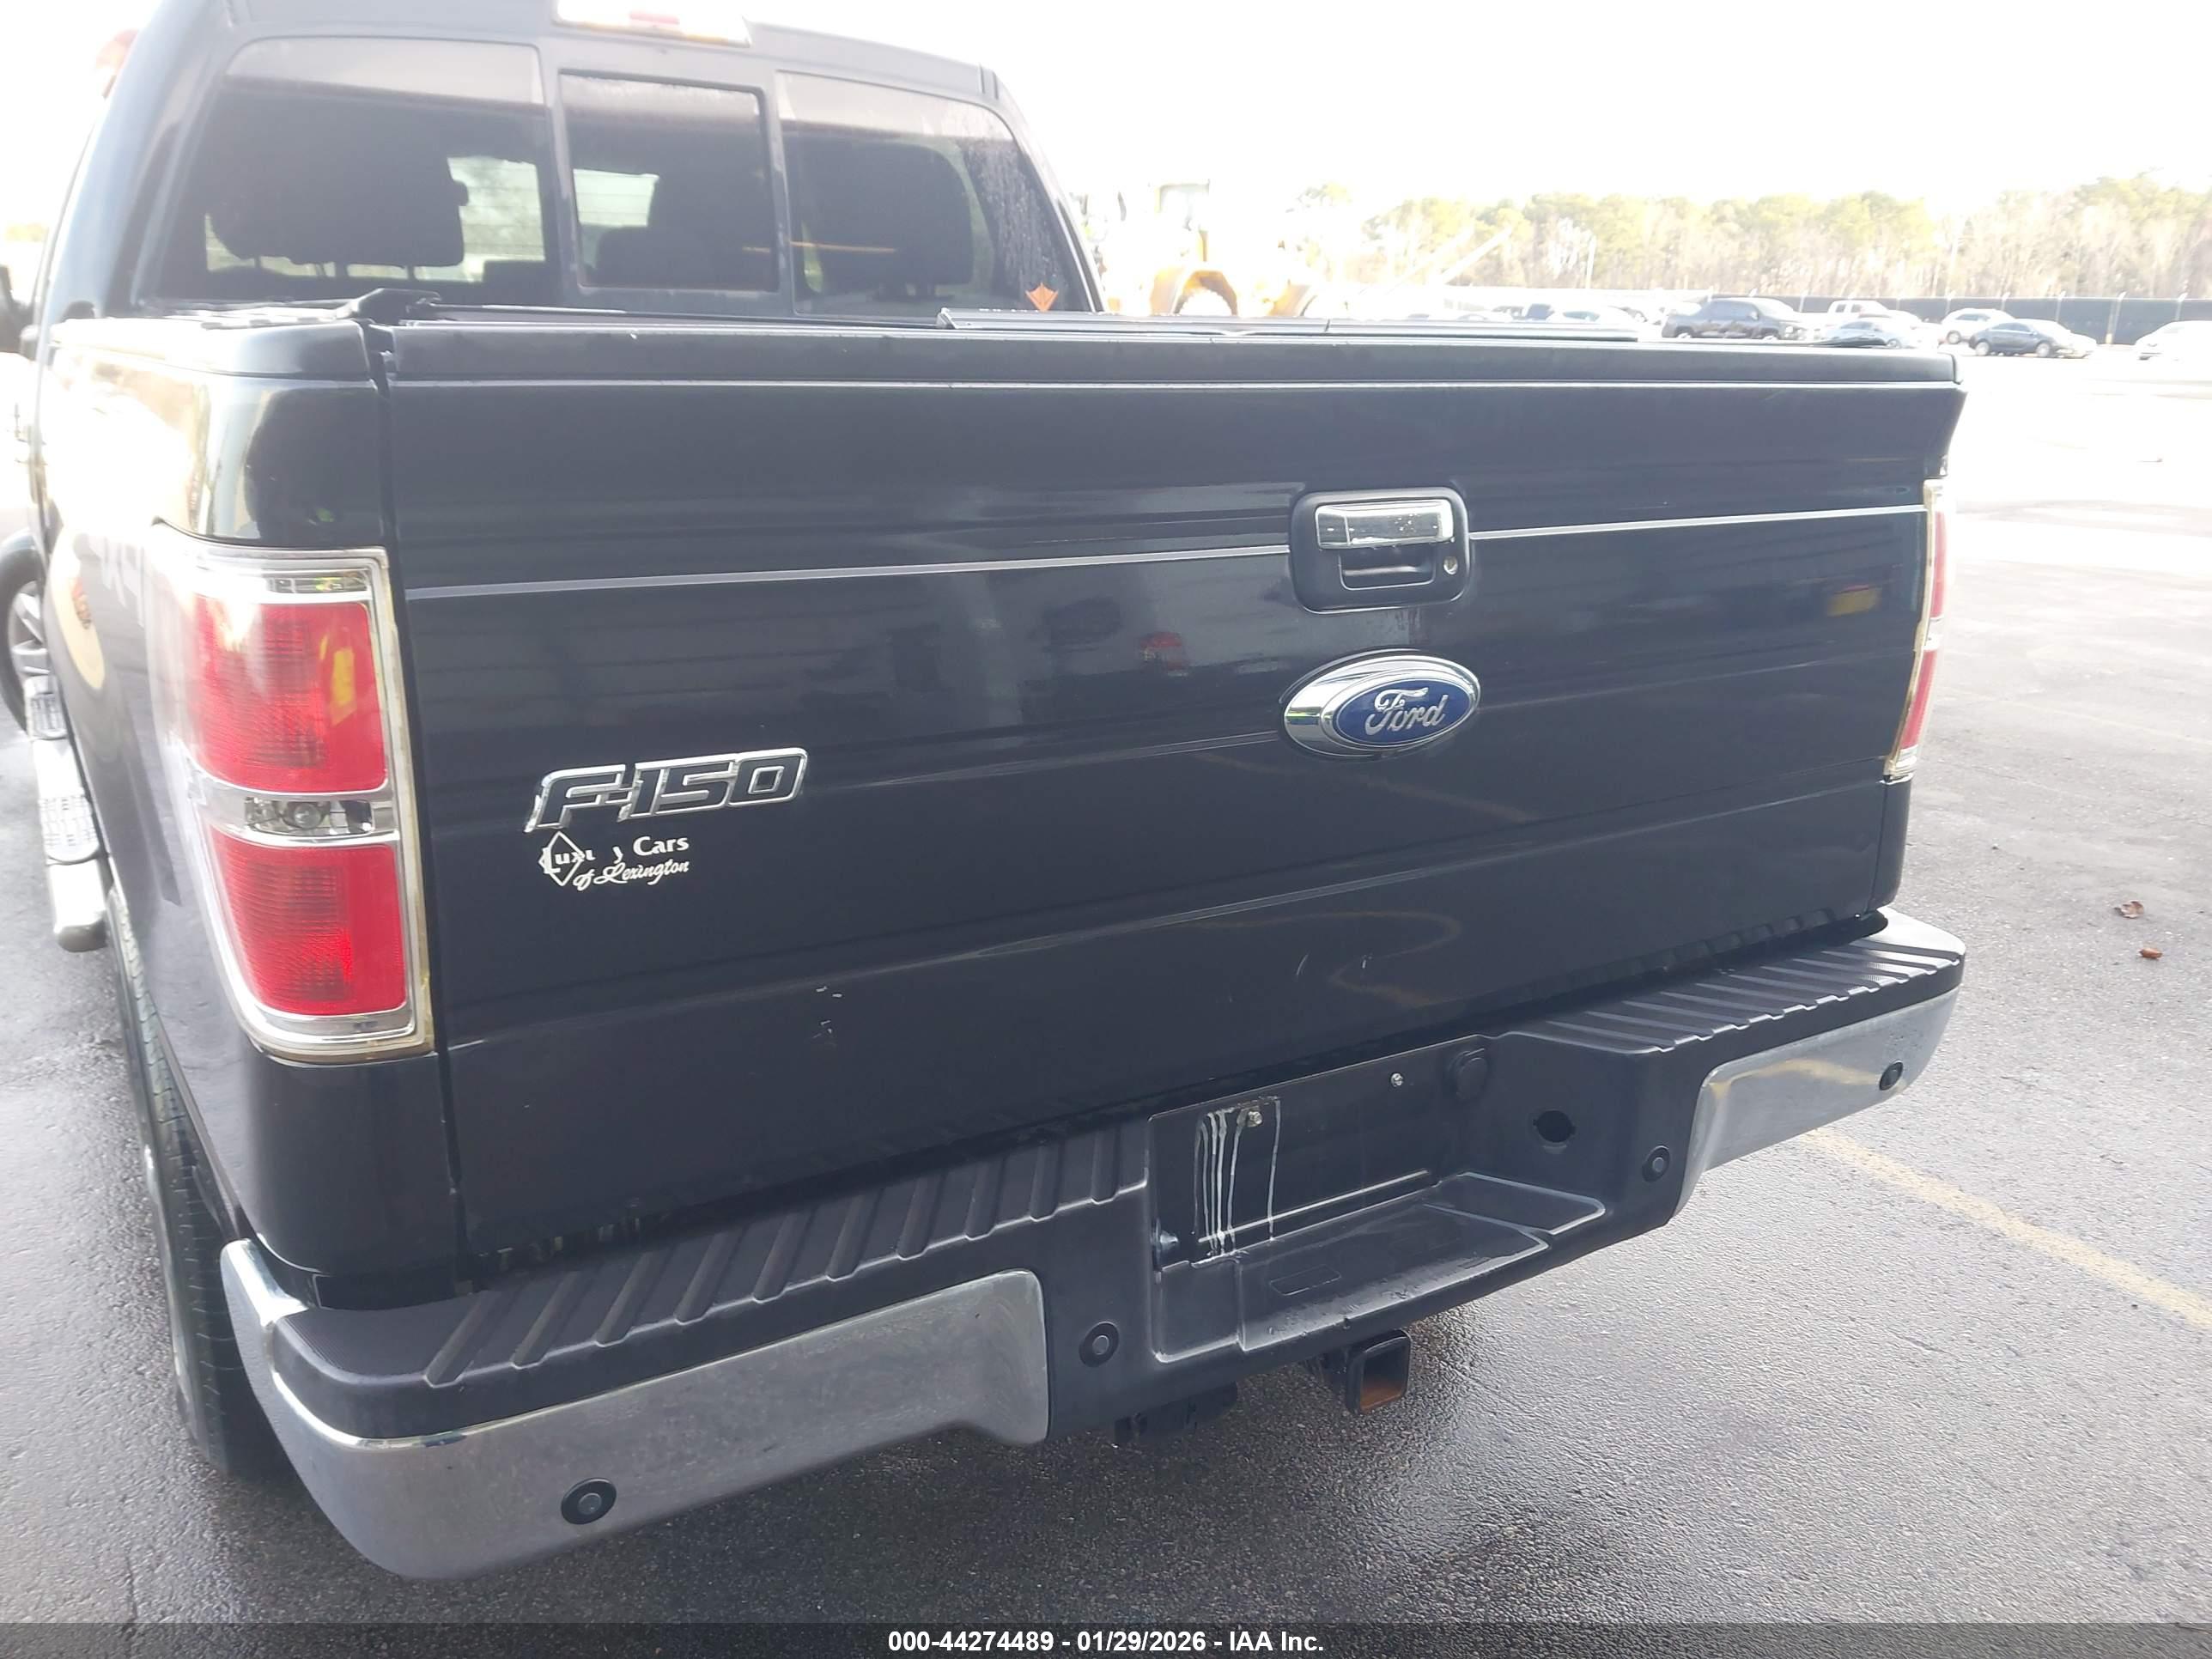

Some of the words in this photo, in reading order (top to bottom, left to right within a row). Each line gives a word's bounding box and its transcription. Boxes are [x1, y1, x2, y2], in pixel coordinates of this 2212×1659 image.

[1364, 686, 1449, 736] Ford
[523, 745, 810, 833] F-150
[633, 836, 690, 856] Cars
[573, 868, 596, 891] of
[593, 858, 690, 885] Lexington
